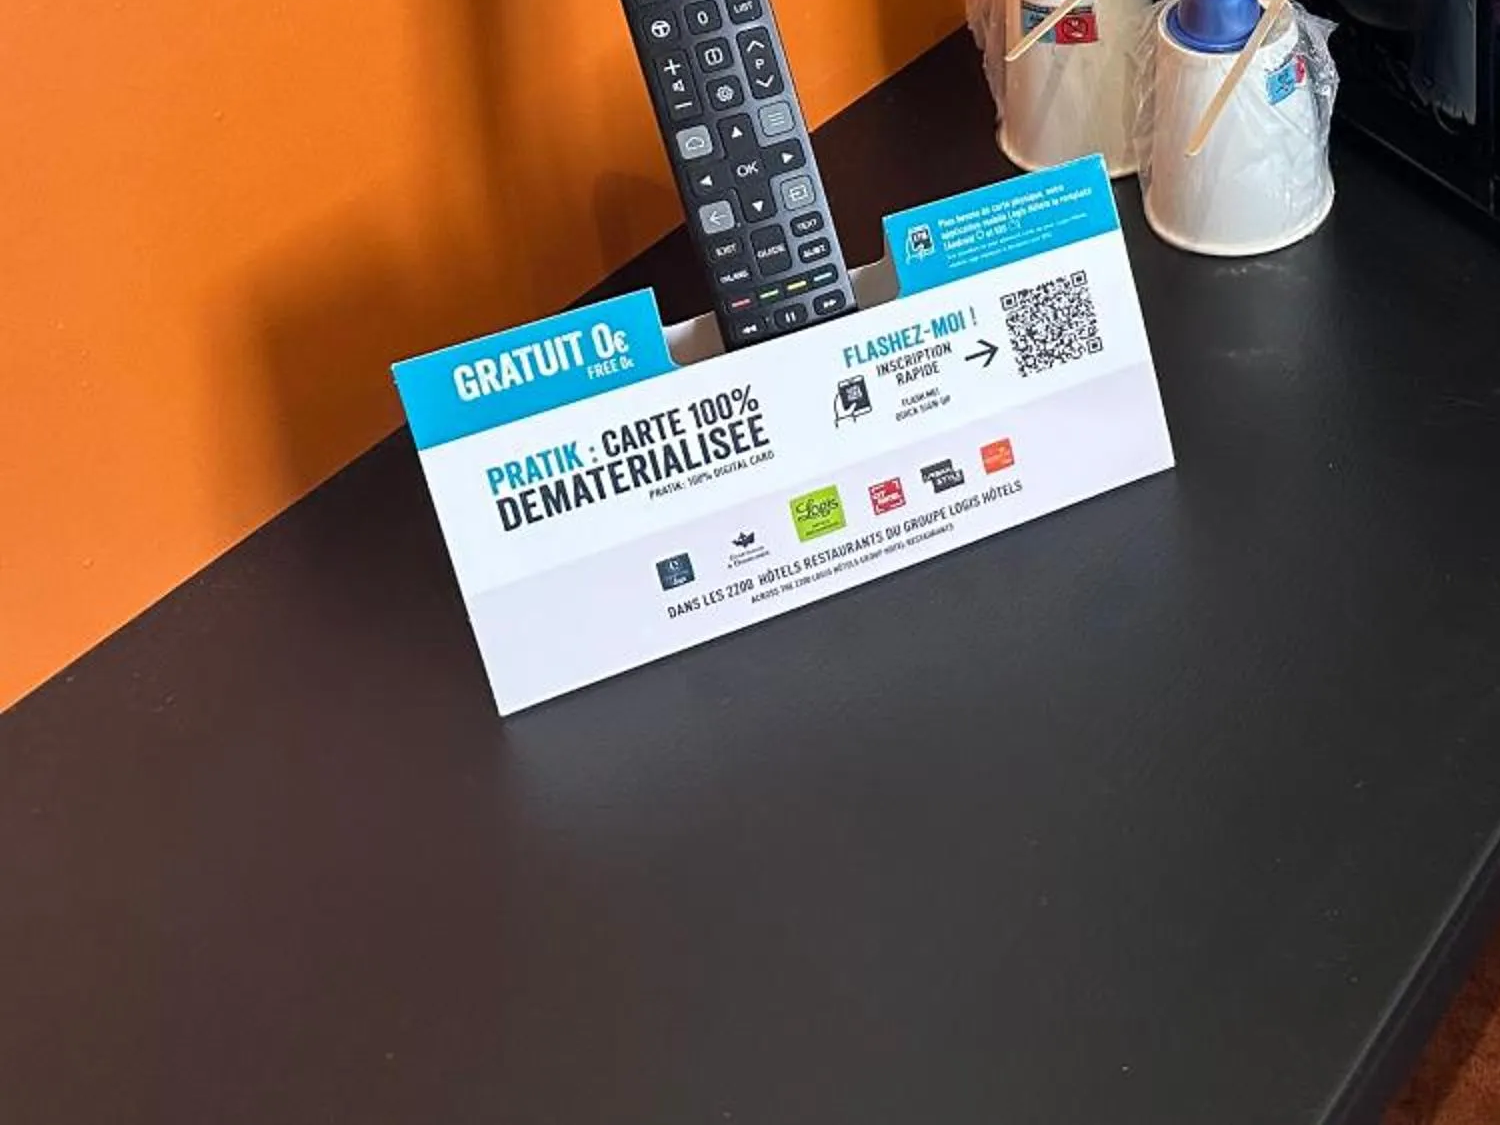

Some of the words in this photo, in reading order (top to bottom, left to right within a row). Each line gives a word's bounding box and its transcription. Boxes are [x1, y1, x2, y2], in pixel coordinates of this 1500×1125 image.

[733, 0, 753, 14] LIST
[755, 58, 765, 70] P
[736, 161, 759, 177] OK
[843, 310, 966, 368] FLASHEZ-MOI
[453, 331, 584, 402] GRATUIT
[592, 322, 629, 359] 0€
[588, 359, 618, 379] FREE
[876, 340, 953, 377] INSCRIPTION
[895, 360, 940, 386] RAPIDE
[486, 441, 584, 495] PRATIK
[601, 408, 686, 457] CARTE
[687, 385, 759, 428] 100%
[496, 413, 770, 532] DEMATERIALISEE
[713, 458, 748, 477] DIGITAL
[749, 450, 775, 466] CARD
[667, 601, 702, 619] DANS
[701, 589, 725, 607] LES
[757, 560, 802, 585] HÔTELS
[803, 531, 884, 569] RESTAURANTS
[885, 523, 902, 540] DU
[903, 507, 947, 533] GROUPE
[949, 494, 982, 518] LOGIS
[983, 480, 1023, 503] HÔTELS
